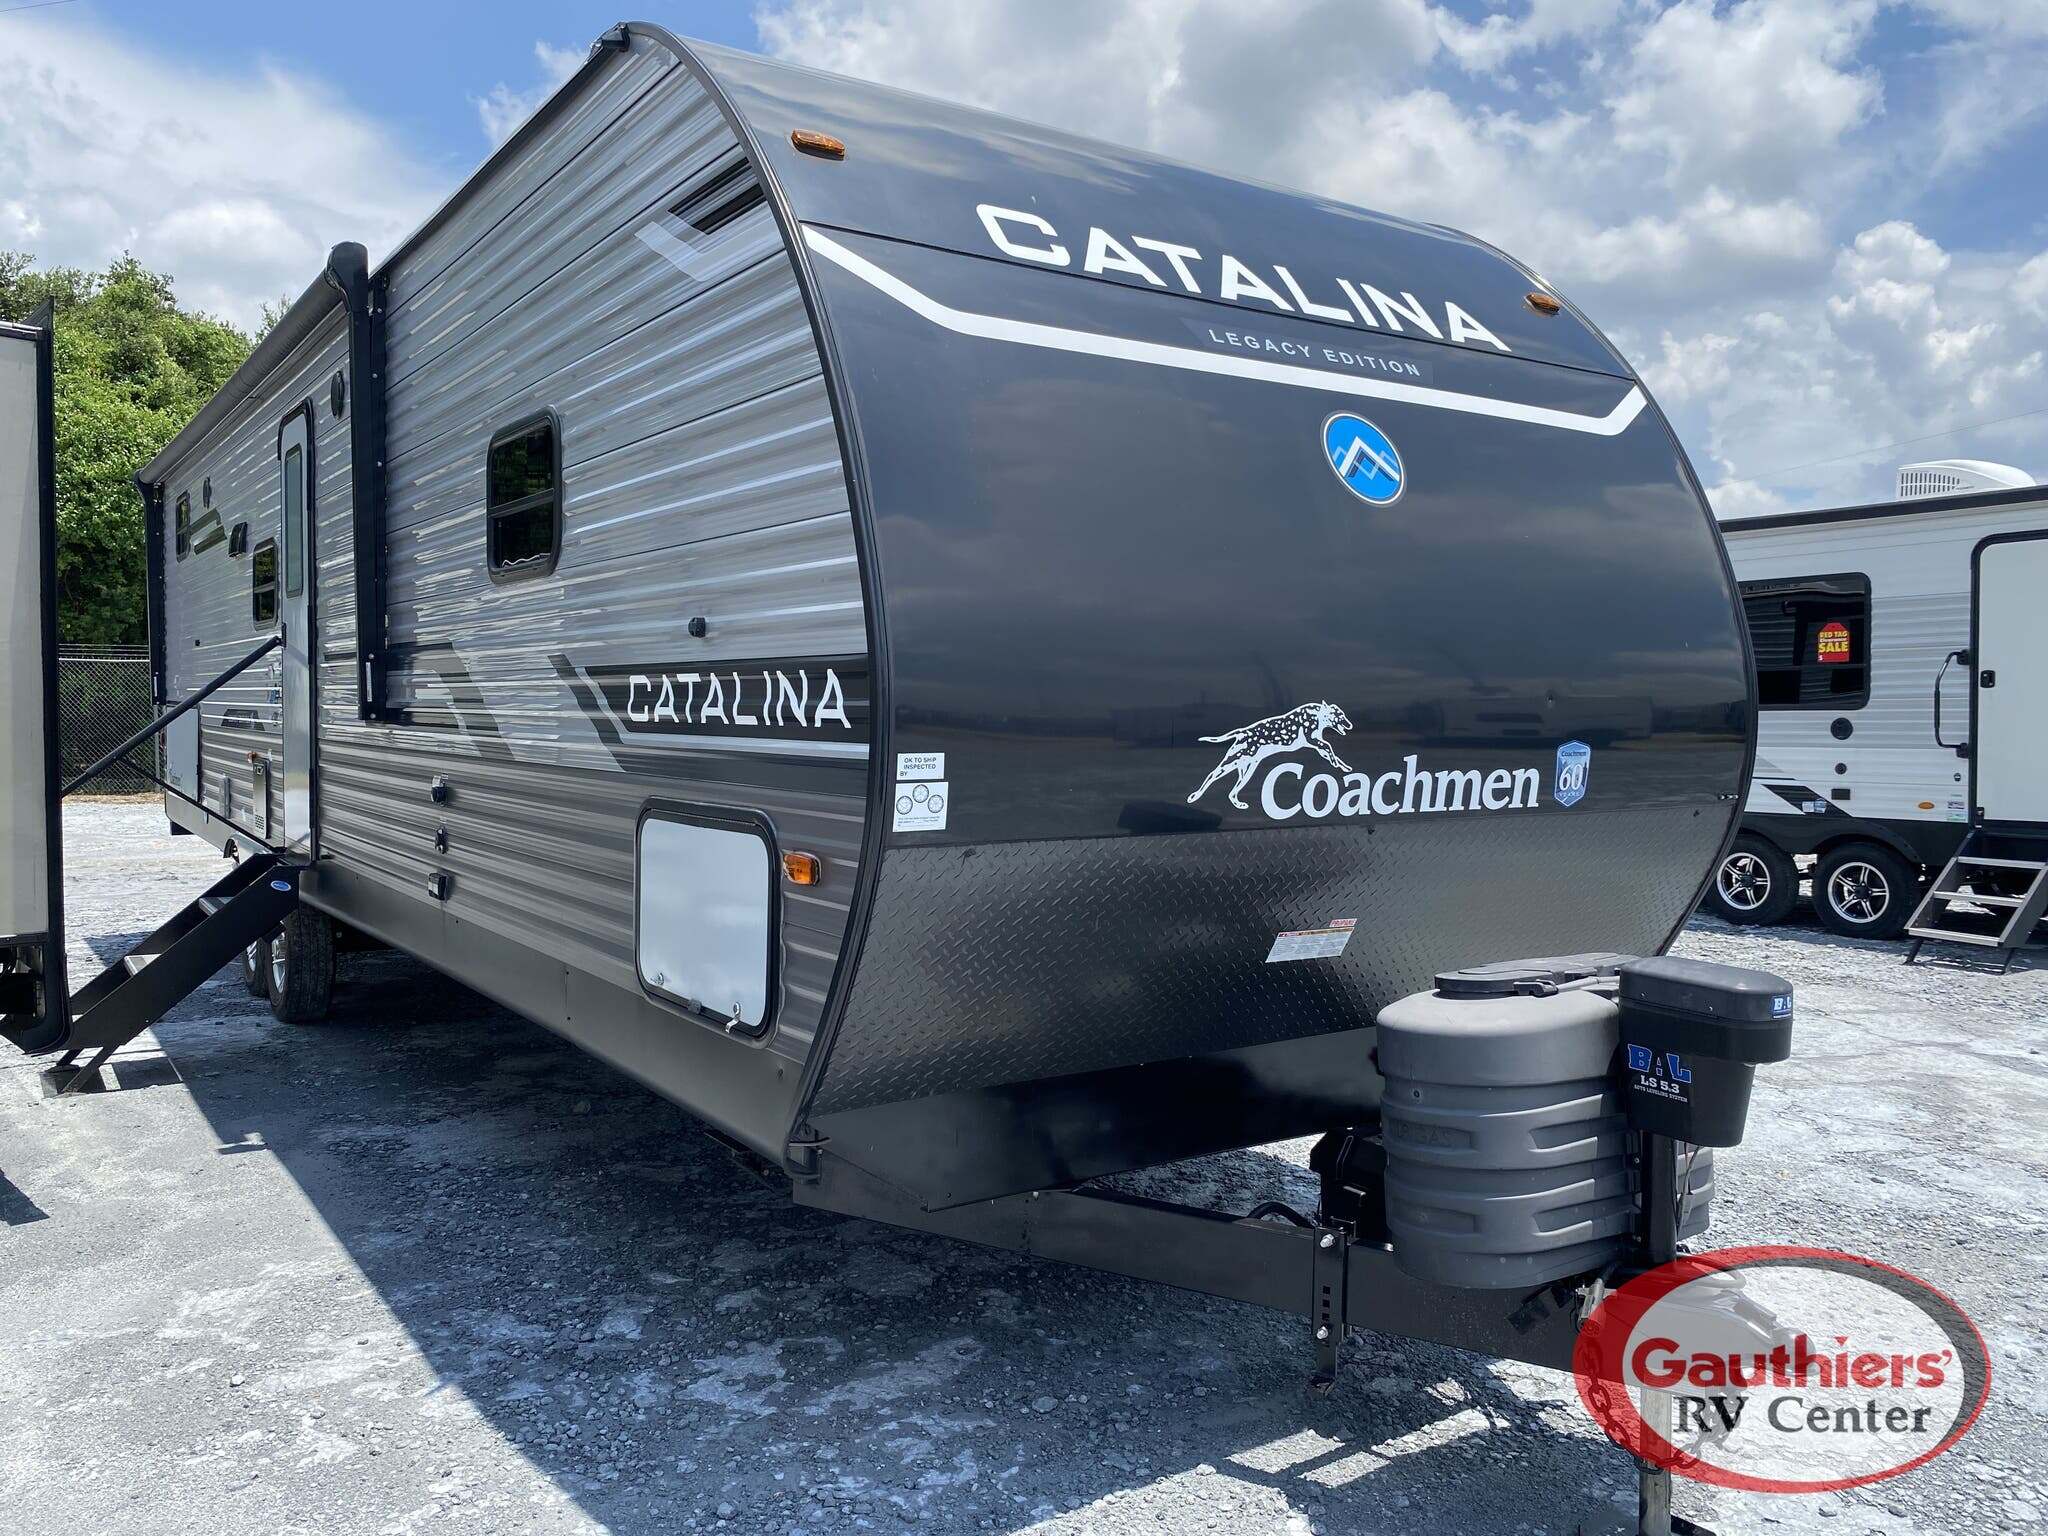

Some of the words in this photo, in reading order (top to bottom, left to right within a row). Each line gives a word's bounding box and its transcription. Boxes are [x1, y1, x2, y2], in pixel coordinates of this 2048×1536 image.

[976, 203, 1512, 352] CATALINA
[1208, 329, 1310, 358] LEGACY
[1322, 348, 1421, 377] EDITION
[1818, 642, 1848, 653] SALE
[626, 668, 852, 729] CATALINA
[1261, 754, 1540, 820] Coachmen
[1559, 763, 1584, 791] 60
[1640, 1074, 1658, 1088] LS
[1660, 1080, 1681, 1094] 5.3
